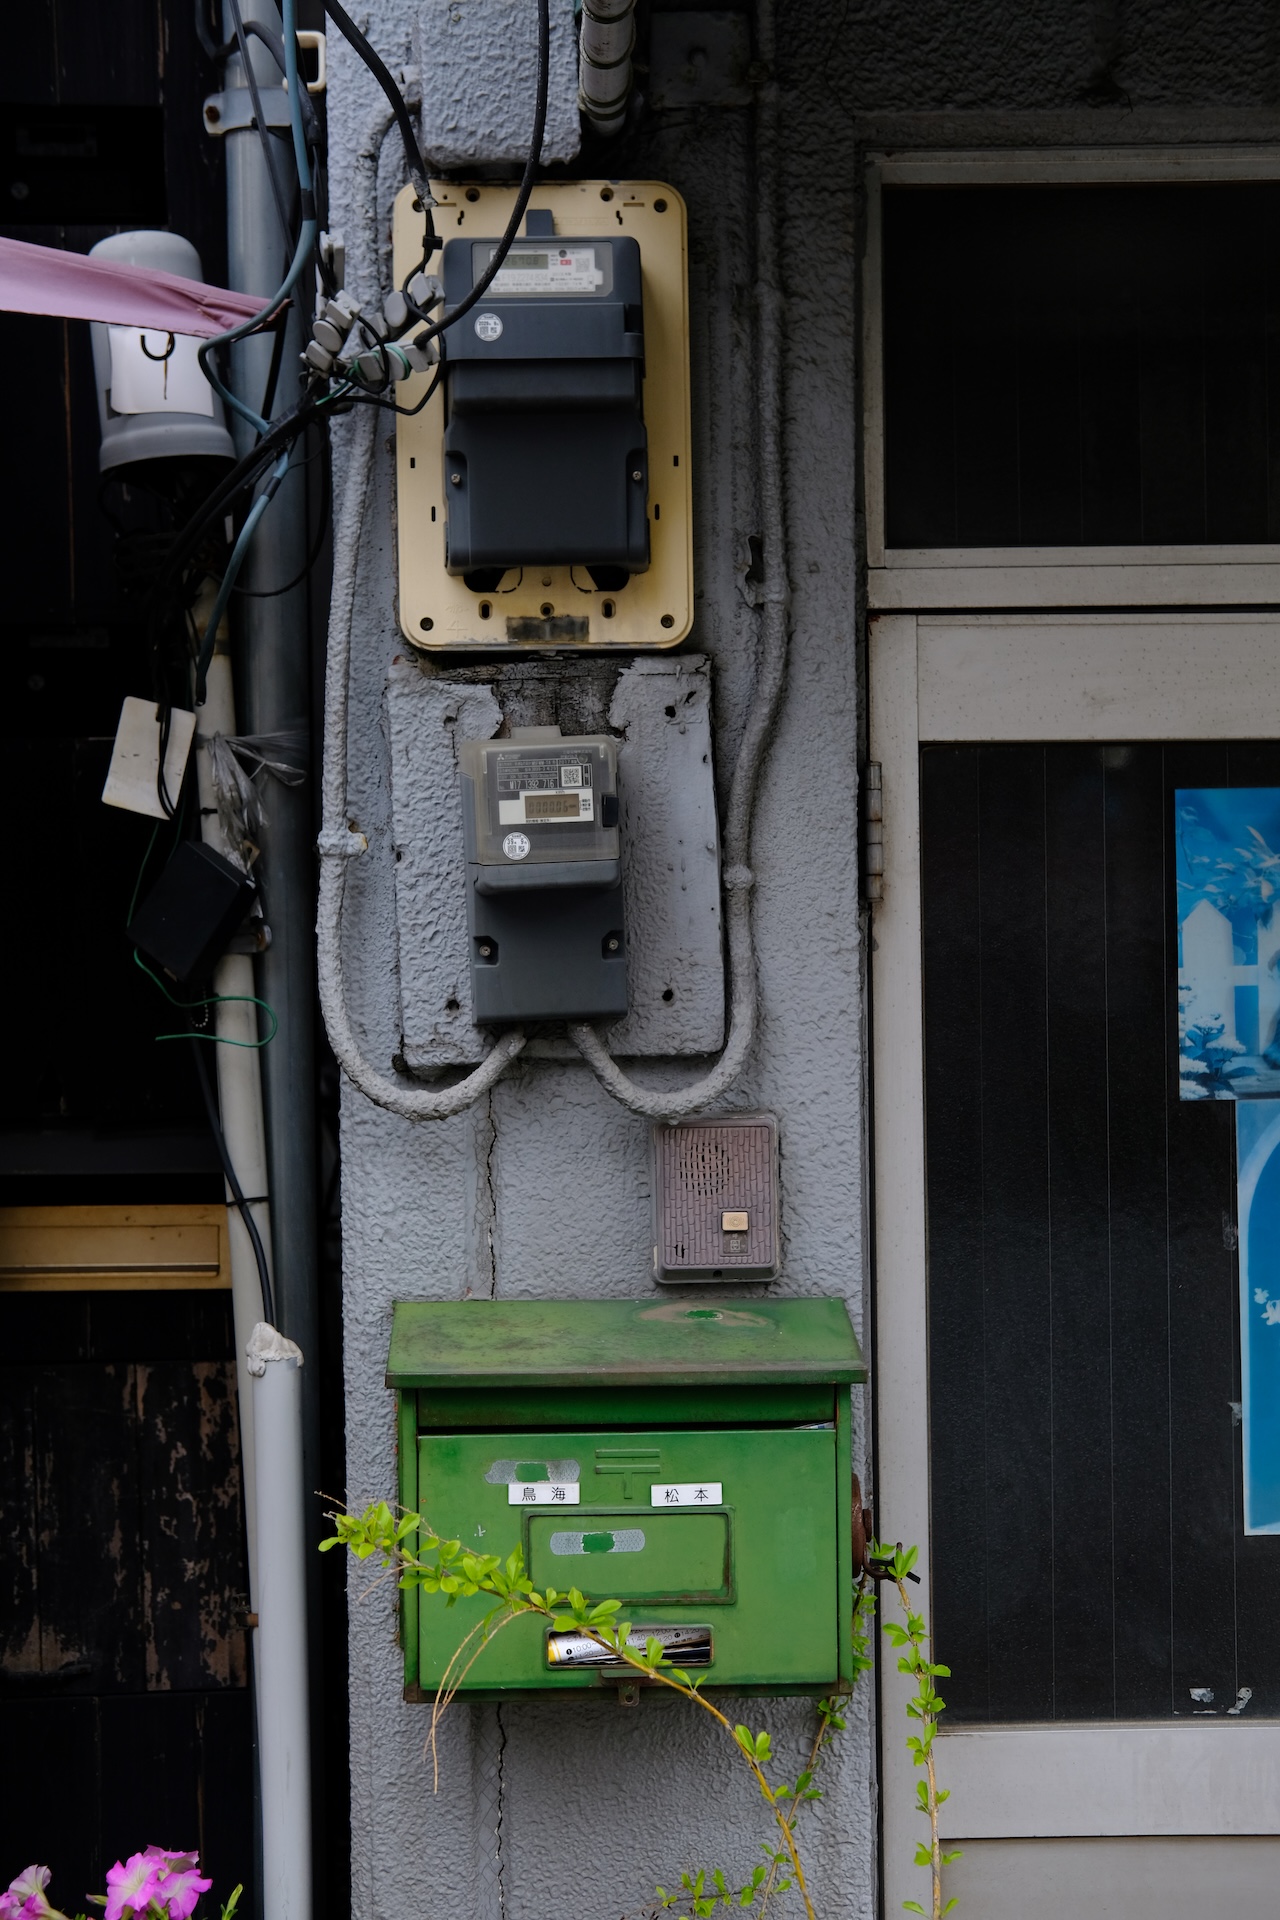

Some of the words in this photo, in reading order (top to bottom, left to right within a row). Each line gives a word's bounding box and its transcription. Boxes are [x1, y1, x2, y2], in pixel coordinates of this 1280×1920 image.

[525, 780, 540, 789] 1392
[542, 779, 555, 788] 716
[522, 1487, 566, 1502] 鳥海
[665, 1488, 709, 1503] 松本
